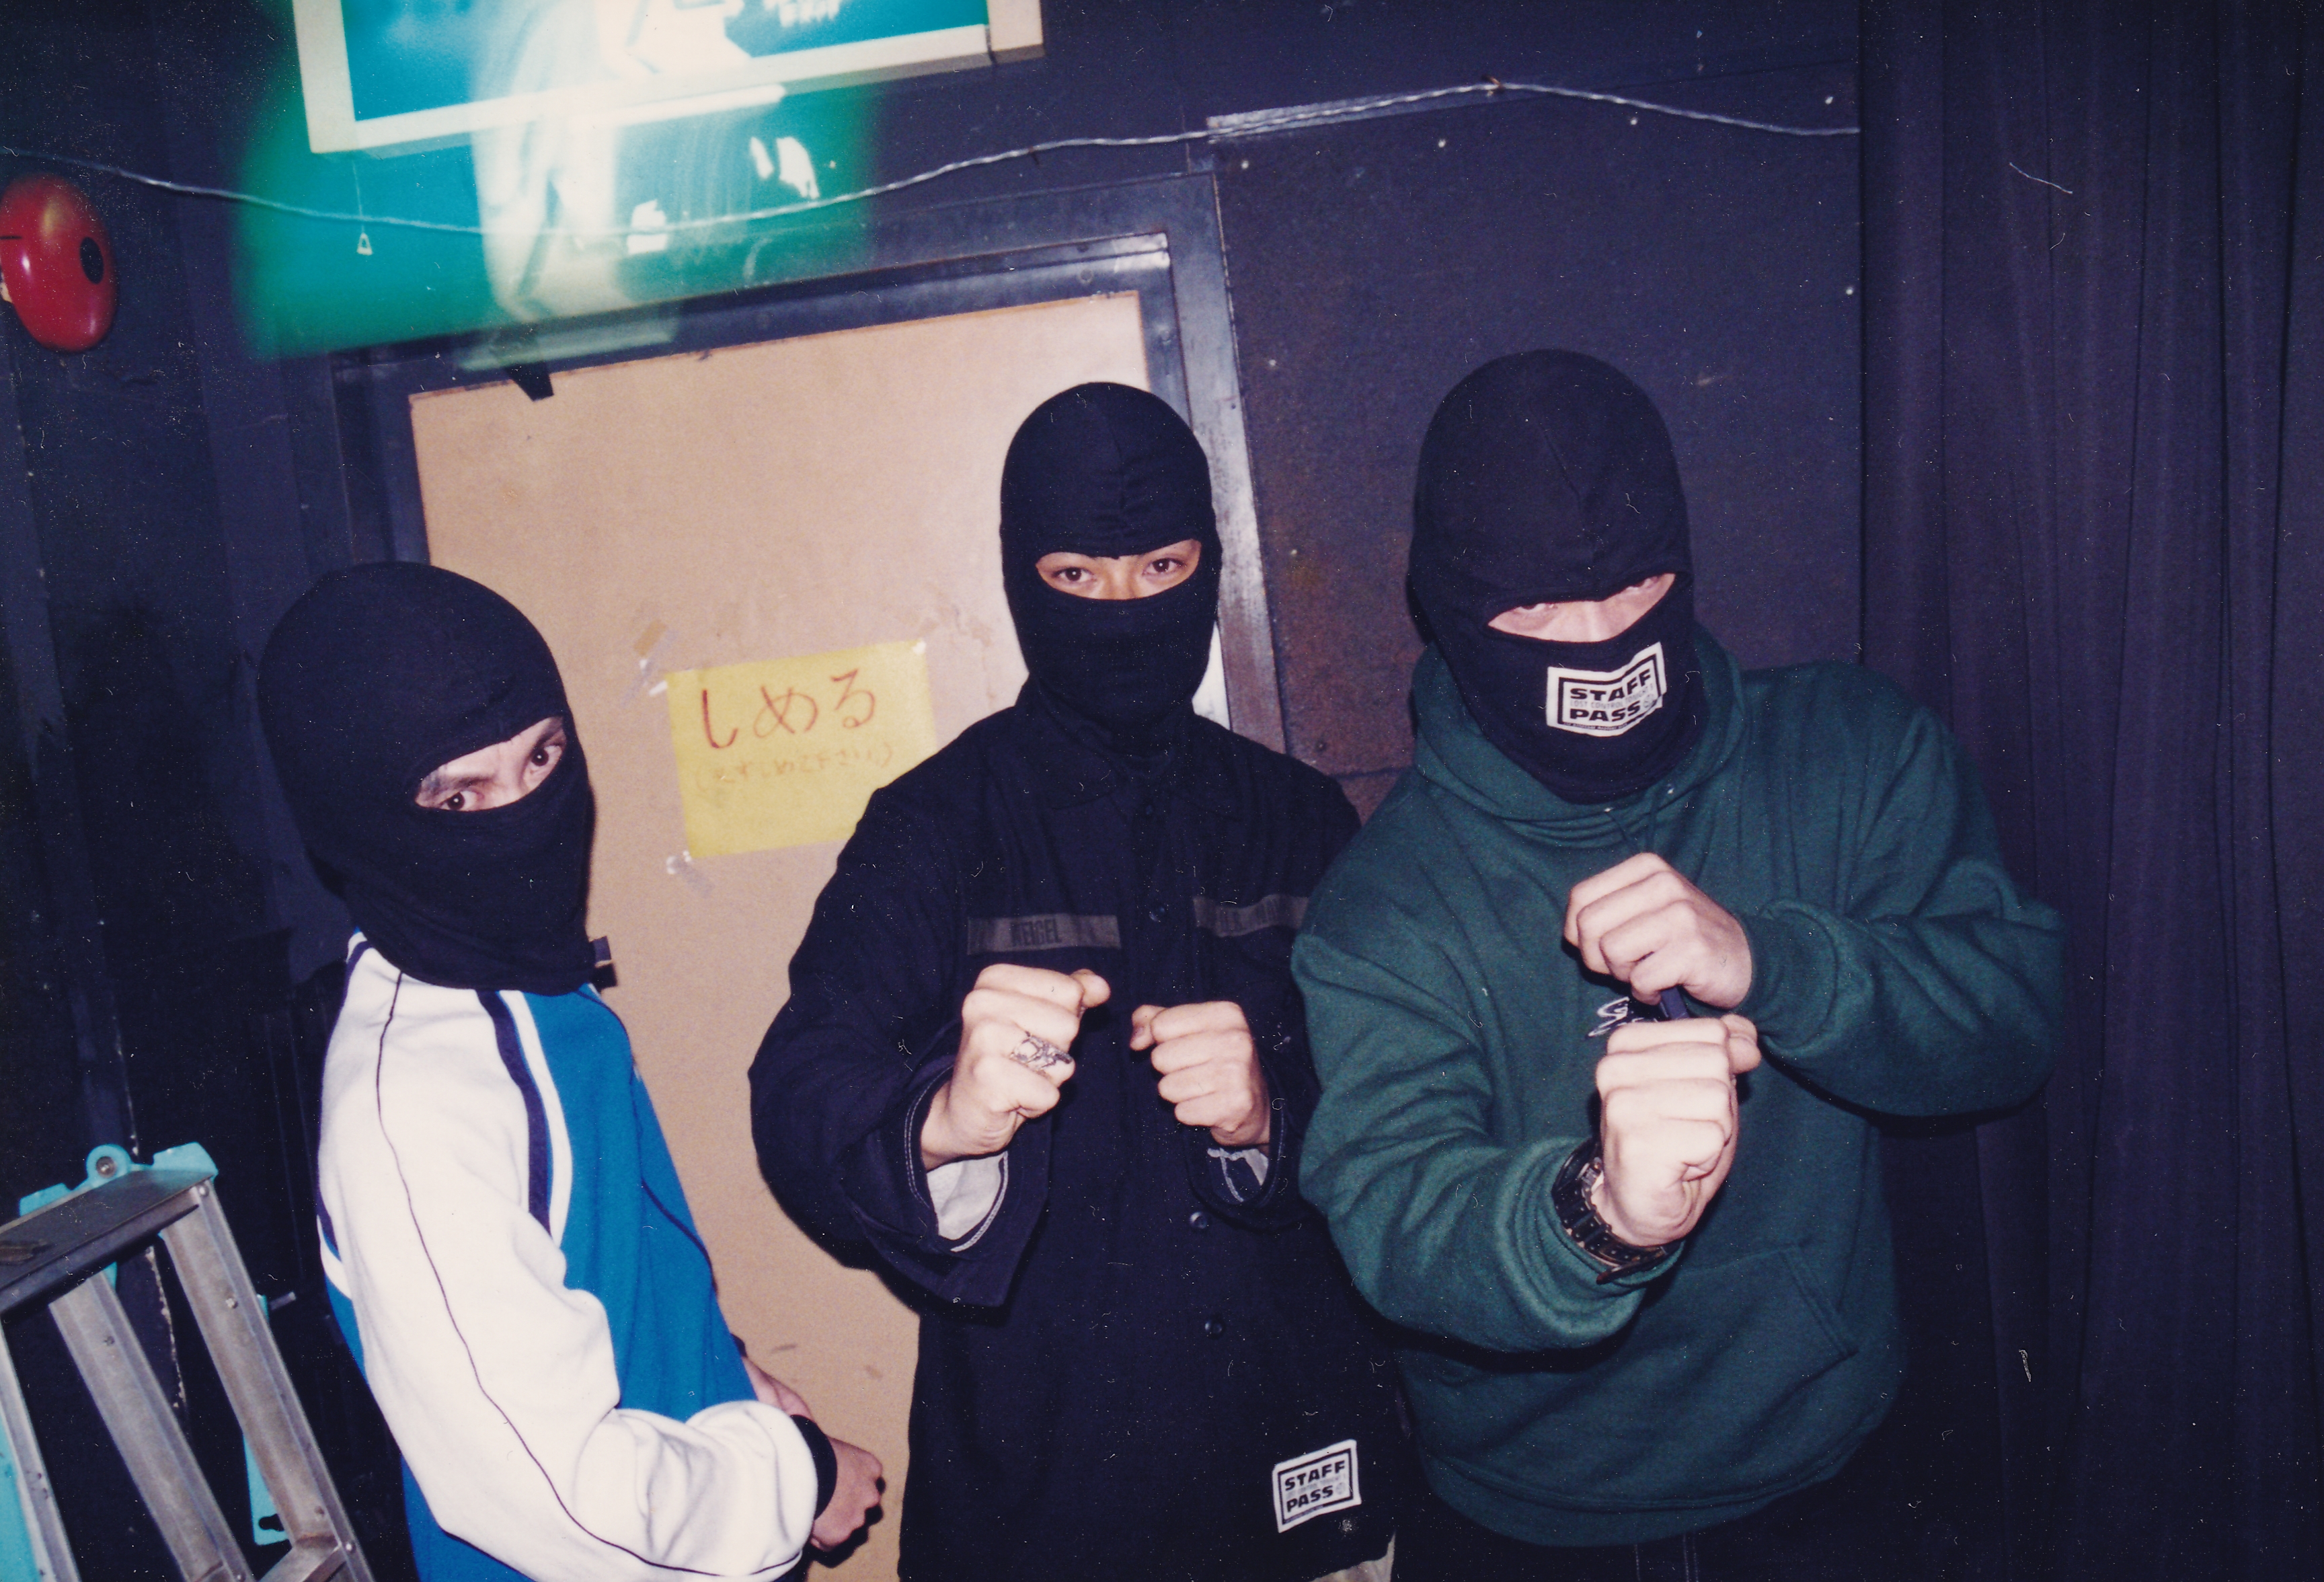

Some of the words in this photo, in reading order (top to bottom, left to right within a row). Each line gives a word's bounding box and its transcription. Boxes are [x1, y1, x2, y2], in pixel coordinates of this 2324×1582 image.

[1570, 669, 1651, 702] STAFF
[701, 669, 876, 749] しめる
[1570, 700, 1640, 722] PASS
[1285, 1460, 1345, 1491] STAFF
[1286, 1485, 1333, 1513] PASS
